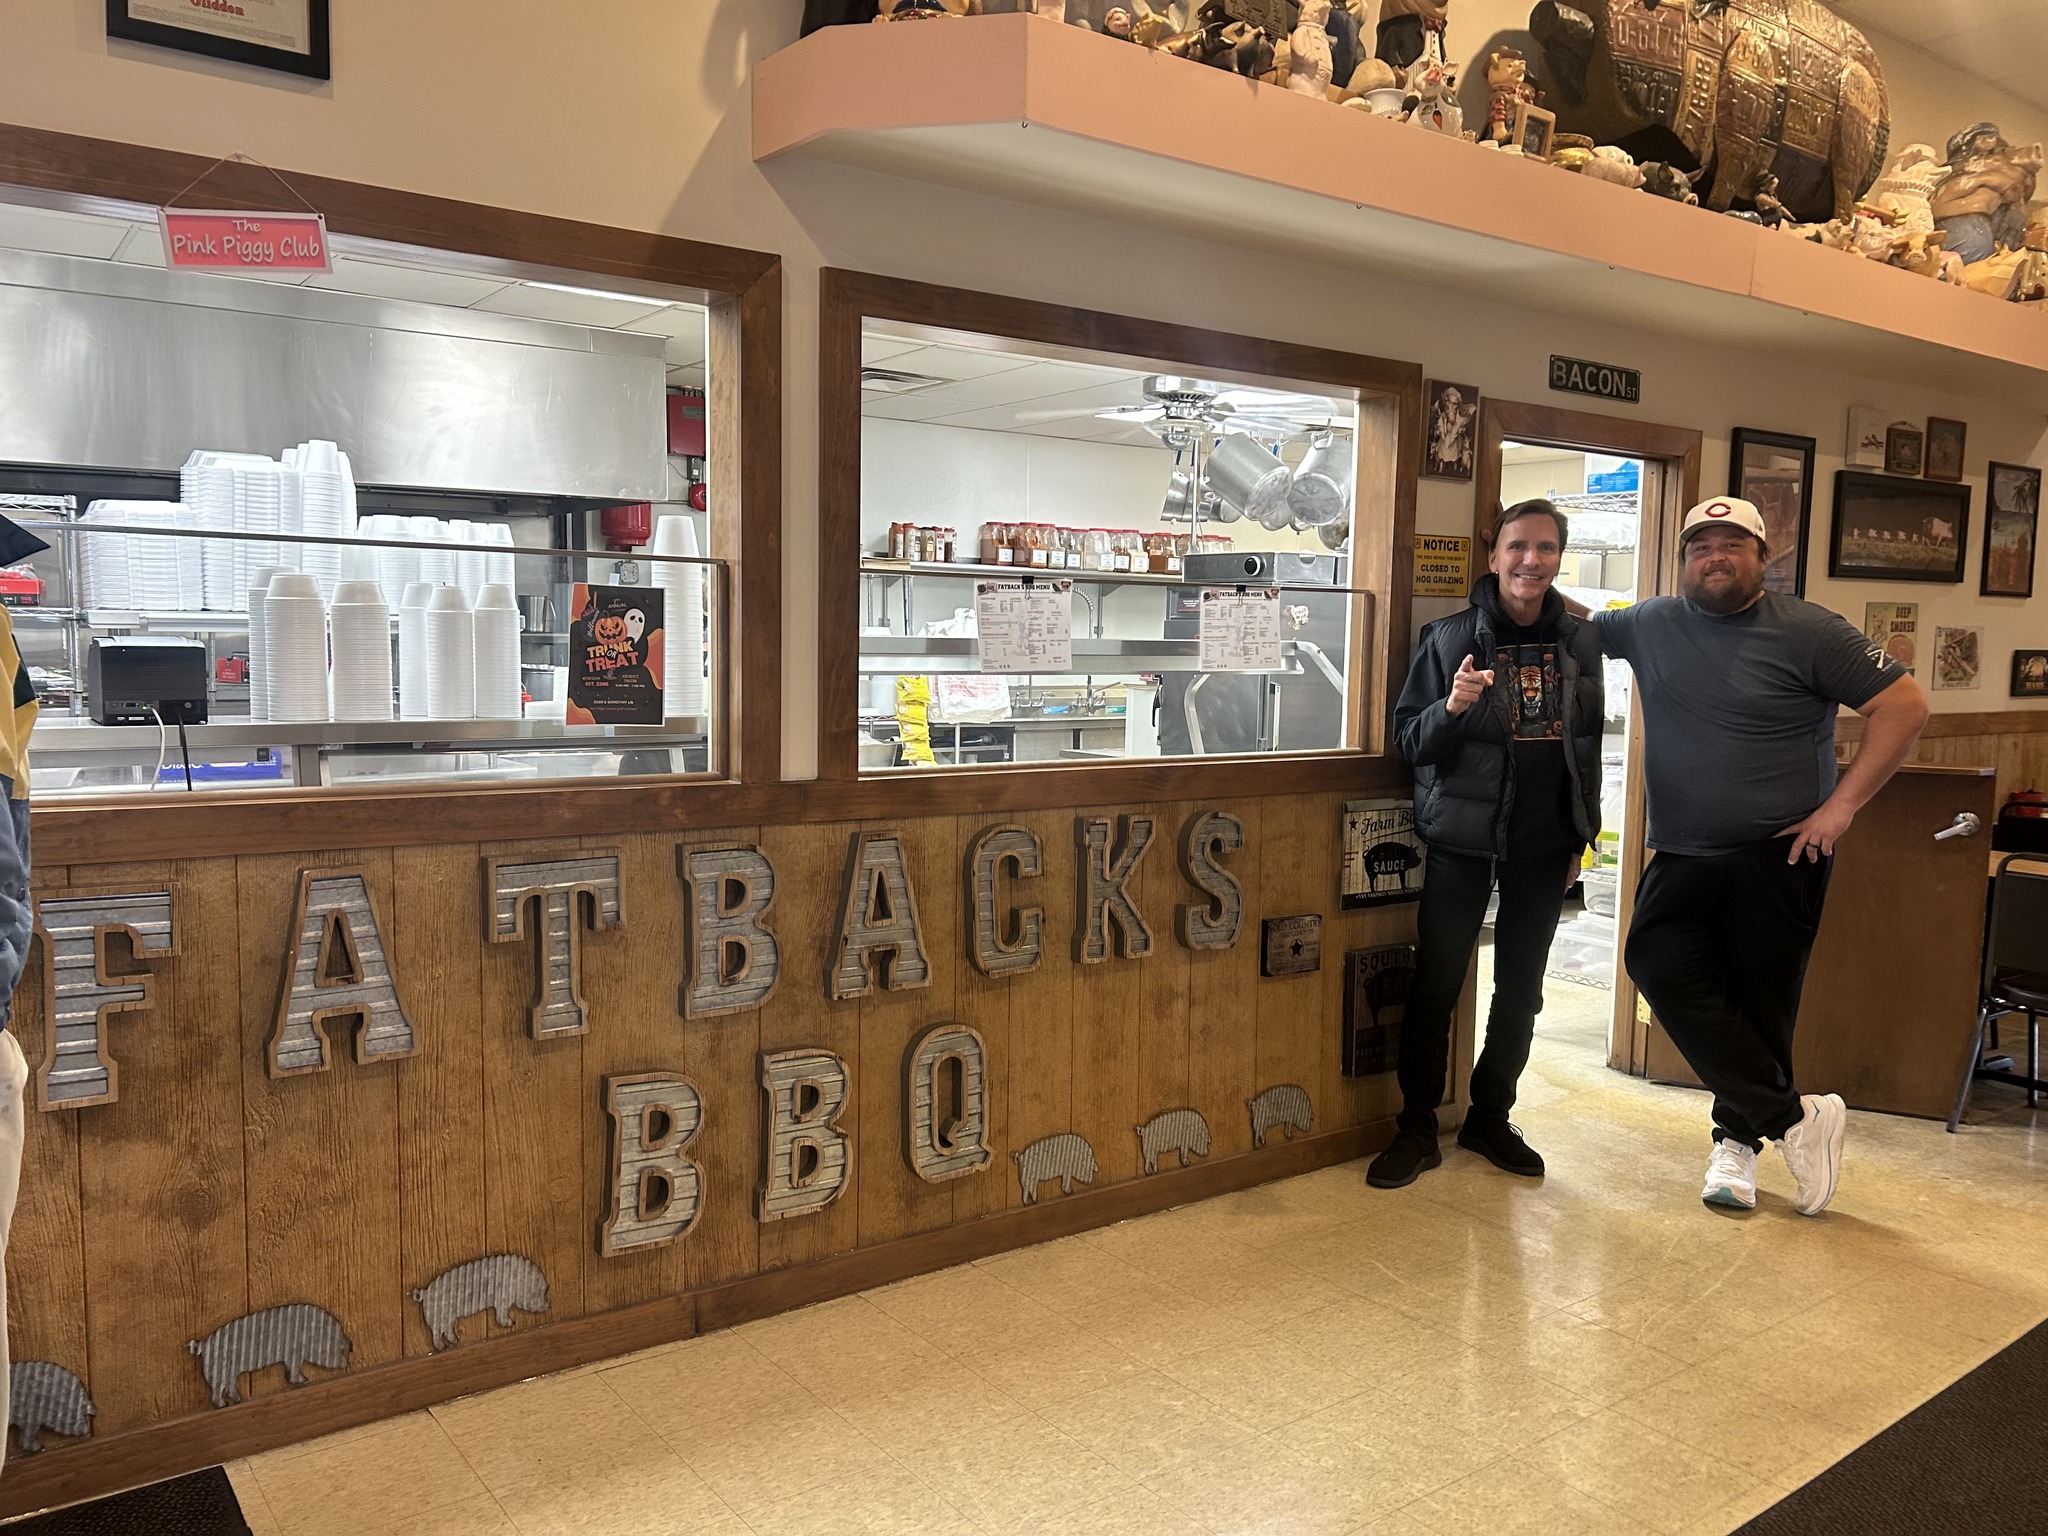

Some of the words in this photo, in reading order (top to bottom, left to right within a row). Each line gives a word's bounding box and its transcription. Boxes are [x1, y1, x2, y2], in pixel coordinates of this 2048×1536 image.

[232, 219, 261, 233] The
[173, 233, 218, 255] Pink
[222, 235, 274, 262] Piggy
[279, 236, 320, 257] Club
[1553, 360, 1626, 397] BACON
[1626, 386, 1637, 399] ST
[1424, 539, 1460, 551] NOTICE
[1420, 564, 1449, 573] CLOSED
[1450, 565, 1460, 573] TO
[1415, 575, 1432, 583] HOG
[1433, 576, 1464, 585] GRAZING
[1895, 606, 1912, 618] DEEP
[1889, 621, 1915, 632] SMOKED
[587, 640, 634, 658] TRUNK
[606, 650, 618, 658] OR
[585, 651, 639, 673] TREAT
[1361, 816, 1395, 835] Farm
[1373, 859, 1406, 873] SAUCE
[36, 812, 1245, 1112] FATBACKS
[600, 1022, 995, 1258] BBQ
